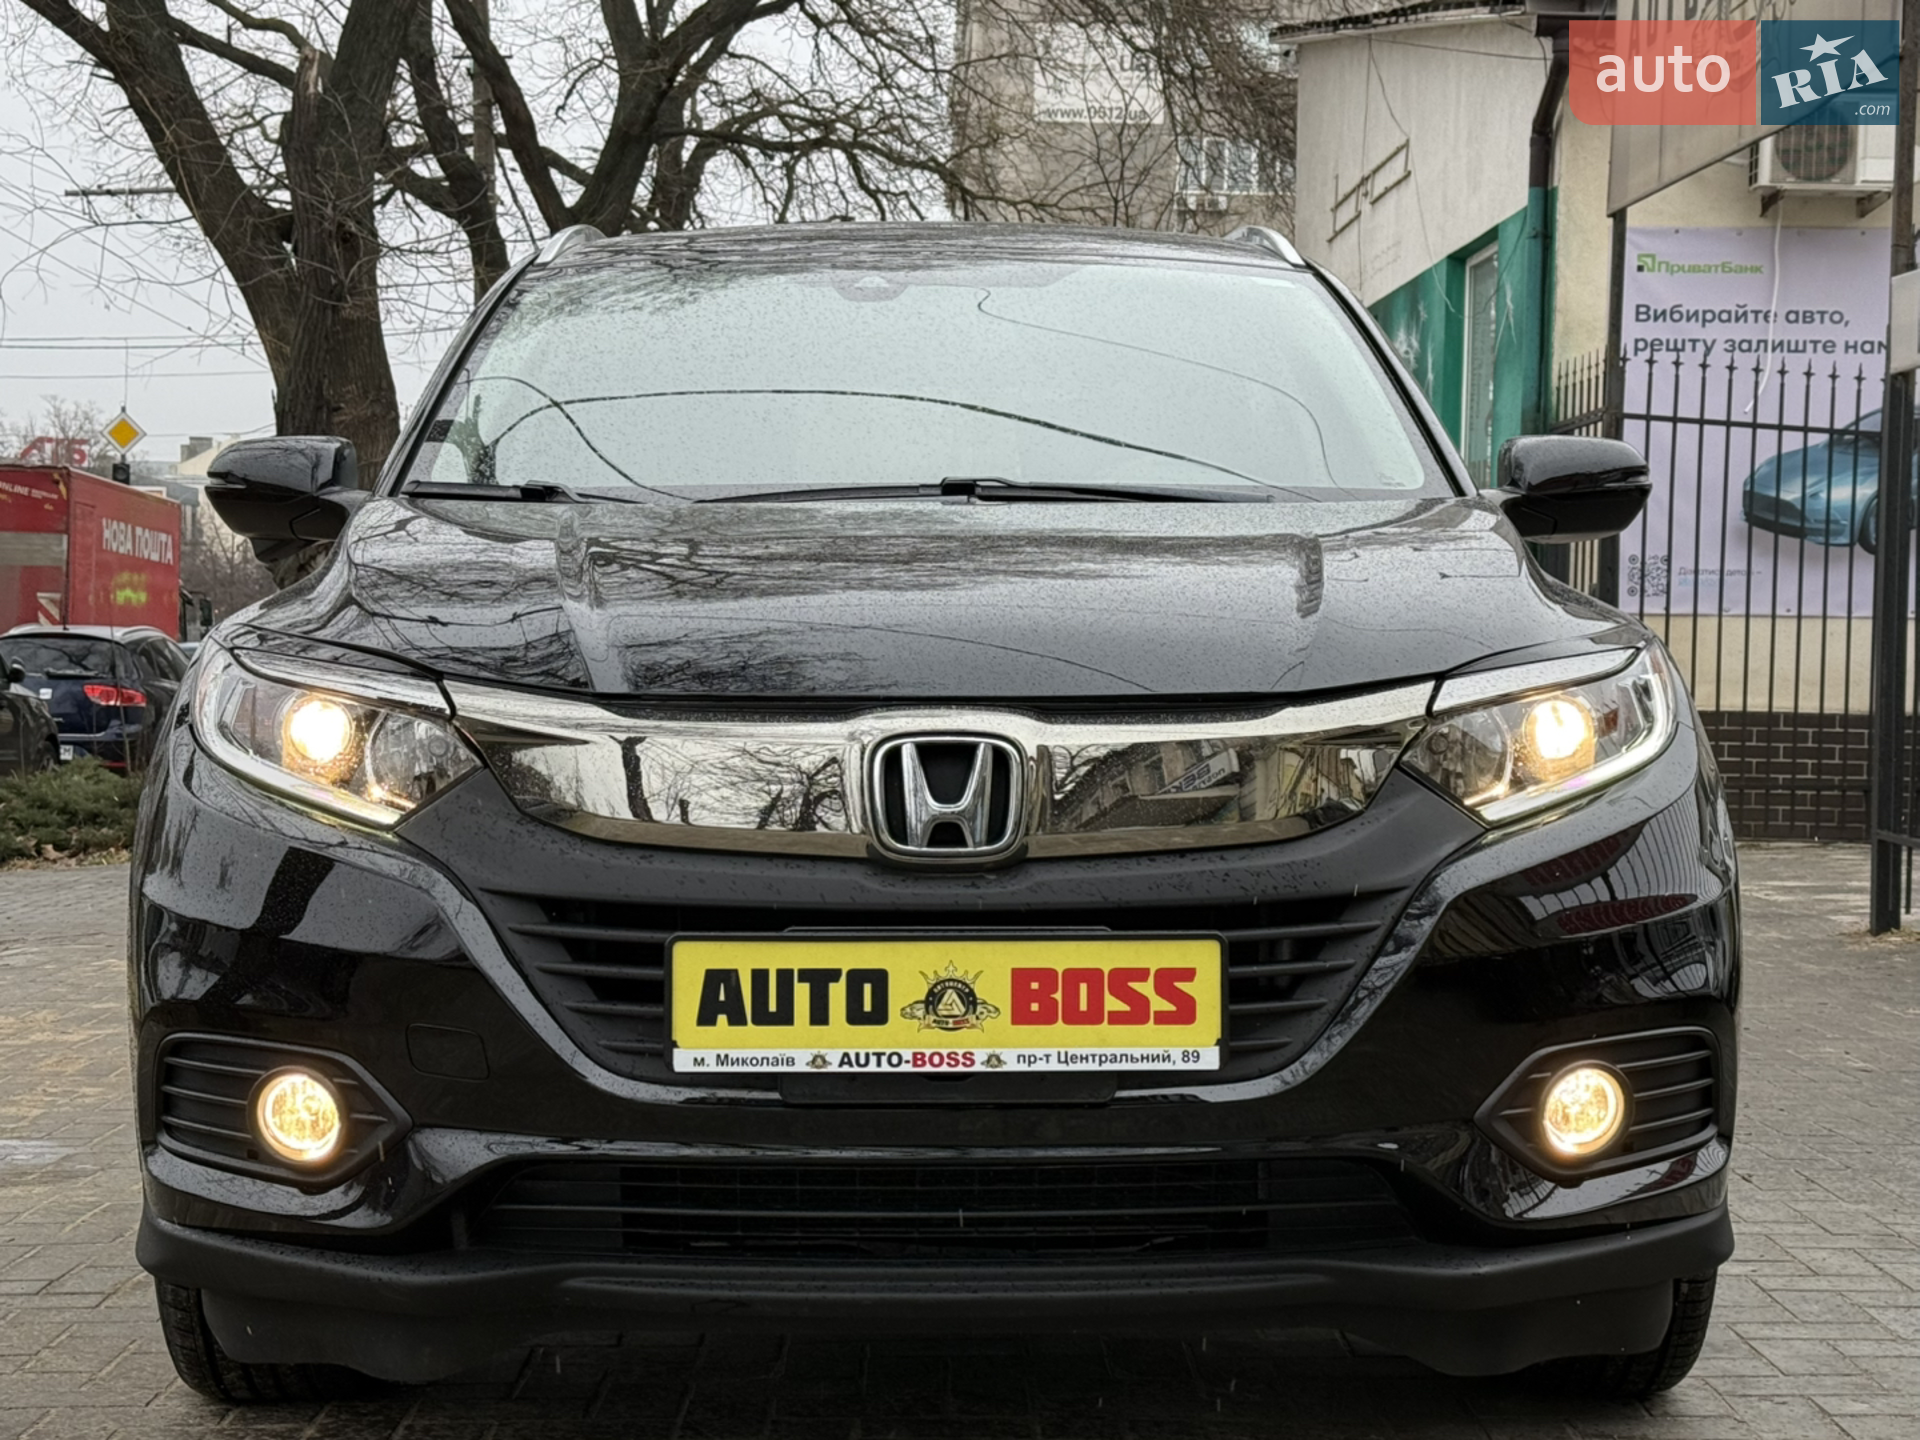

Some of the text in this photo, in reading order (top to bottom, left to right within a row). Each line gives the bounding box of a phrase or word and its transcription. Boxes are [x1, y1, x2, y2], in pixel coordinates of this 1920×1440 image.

[1657, 260, 1764, 275] ПриватБанк
[1635, 304, 1850, 328] Вибирайте авто,
[1634, 337, 1717, 357] решту
[1724, 339, 1837, 355] залиште
[0, 481, 30, 497] NLINE
[102, 517, 174, 566] НОВА ПОШТА
[696, 967, 1197, 1027] AUTO BOSS
[692, 1049, 1201, 1068] м. Миколаїв AUTO-BOSS пр-т Центральний, 89
